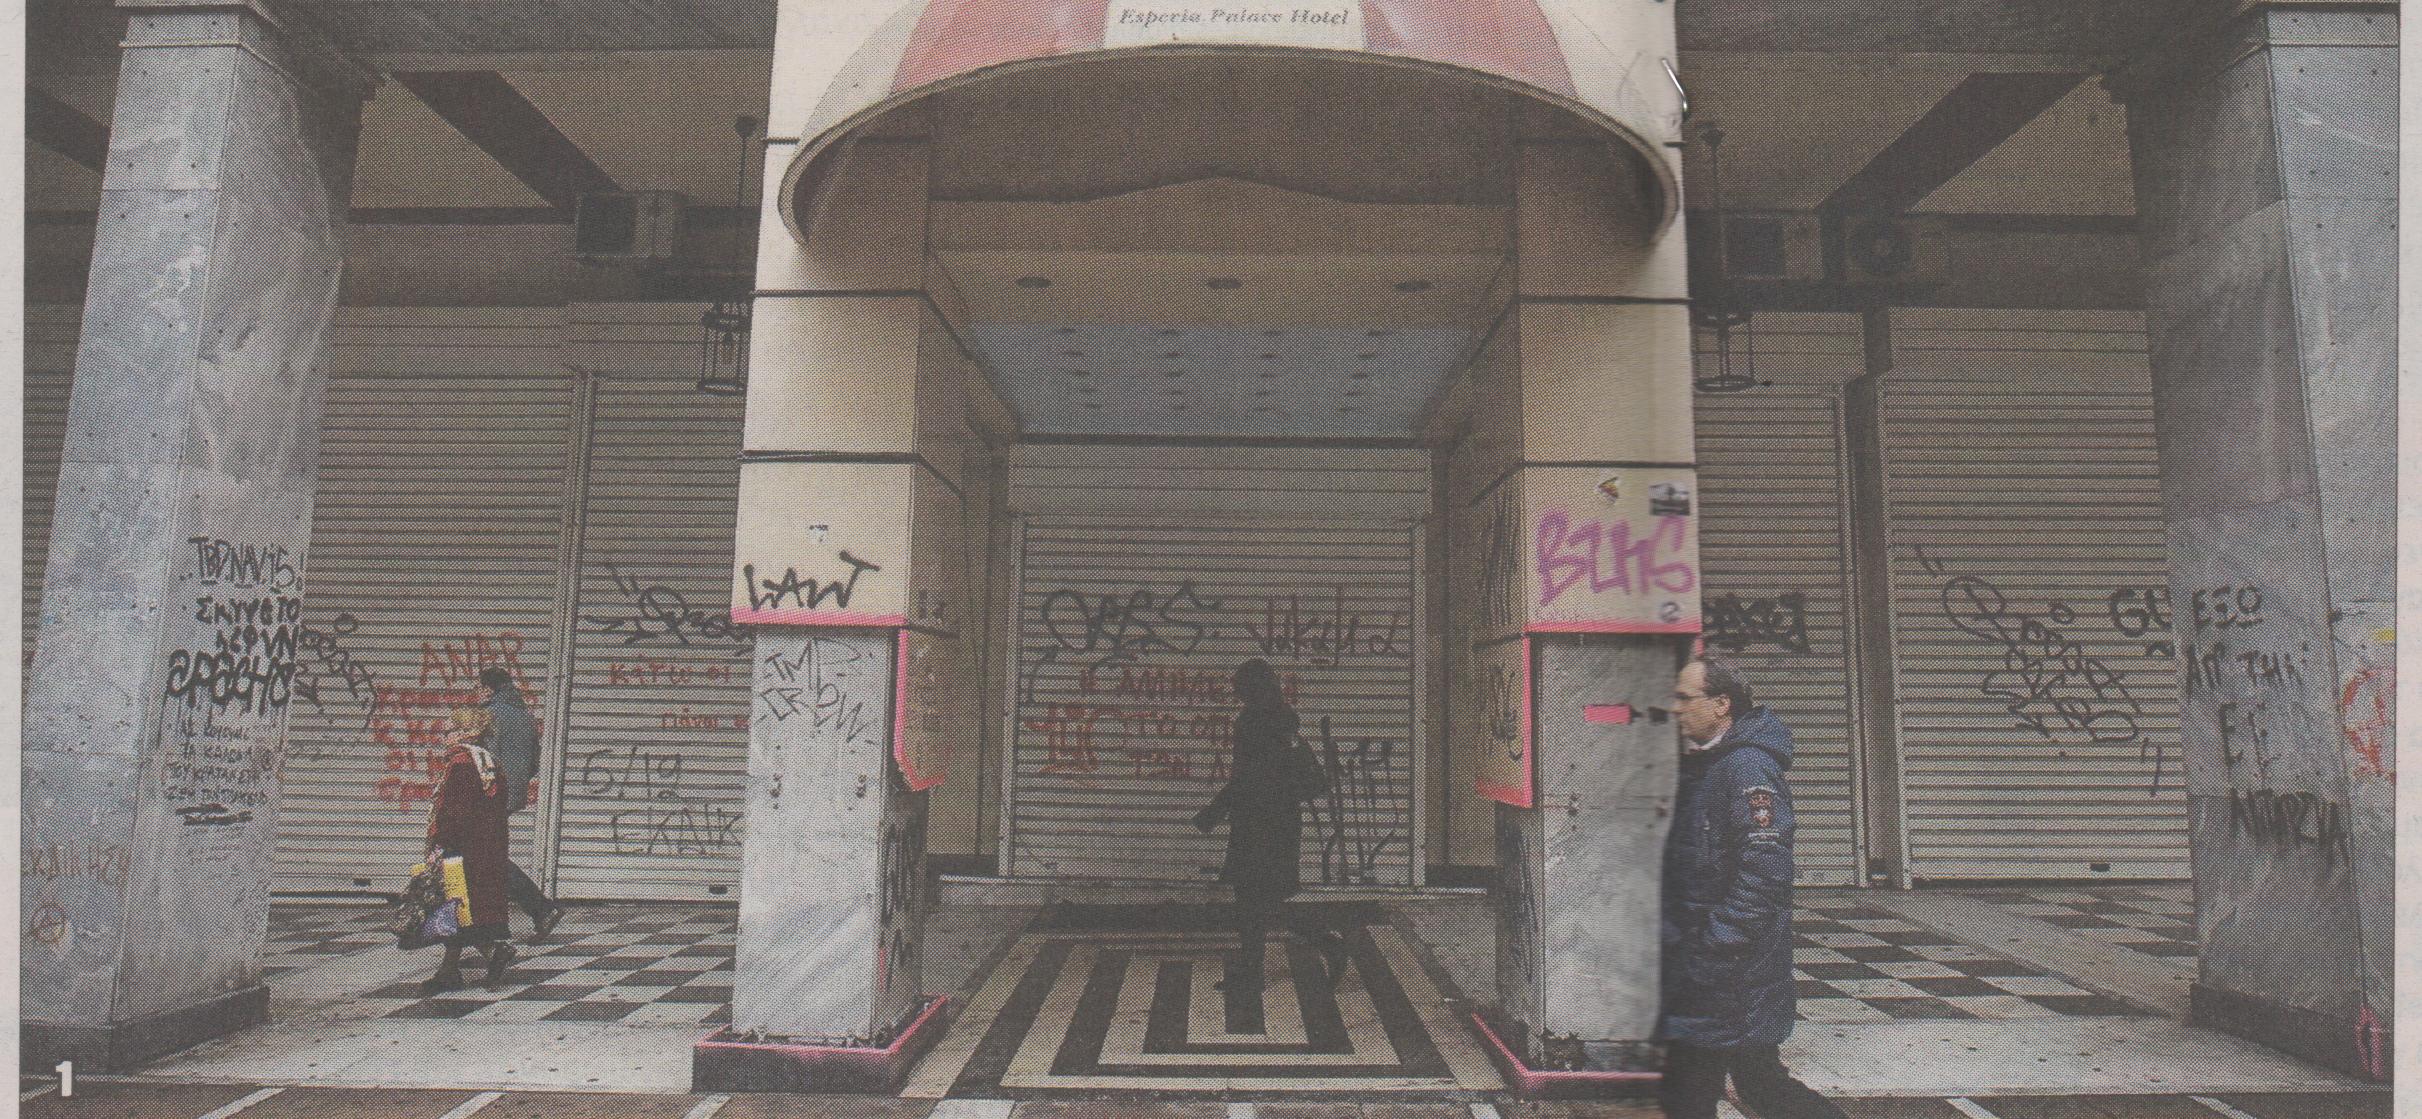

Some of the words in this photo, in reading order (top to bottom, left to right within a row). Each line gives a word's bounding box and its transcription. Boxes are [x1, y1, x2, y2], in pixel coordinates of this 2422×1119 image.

[1119, 8, 1201, 28] Esperia
[1210, 8, 1282, 24] Palace
[1290, 9, 1349, 26] Hotel
